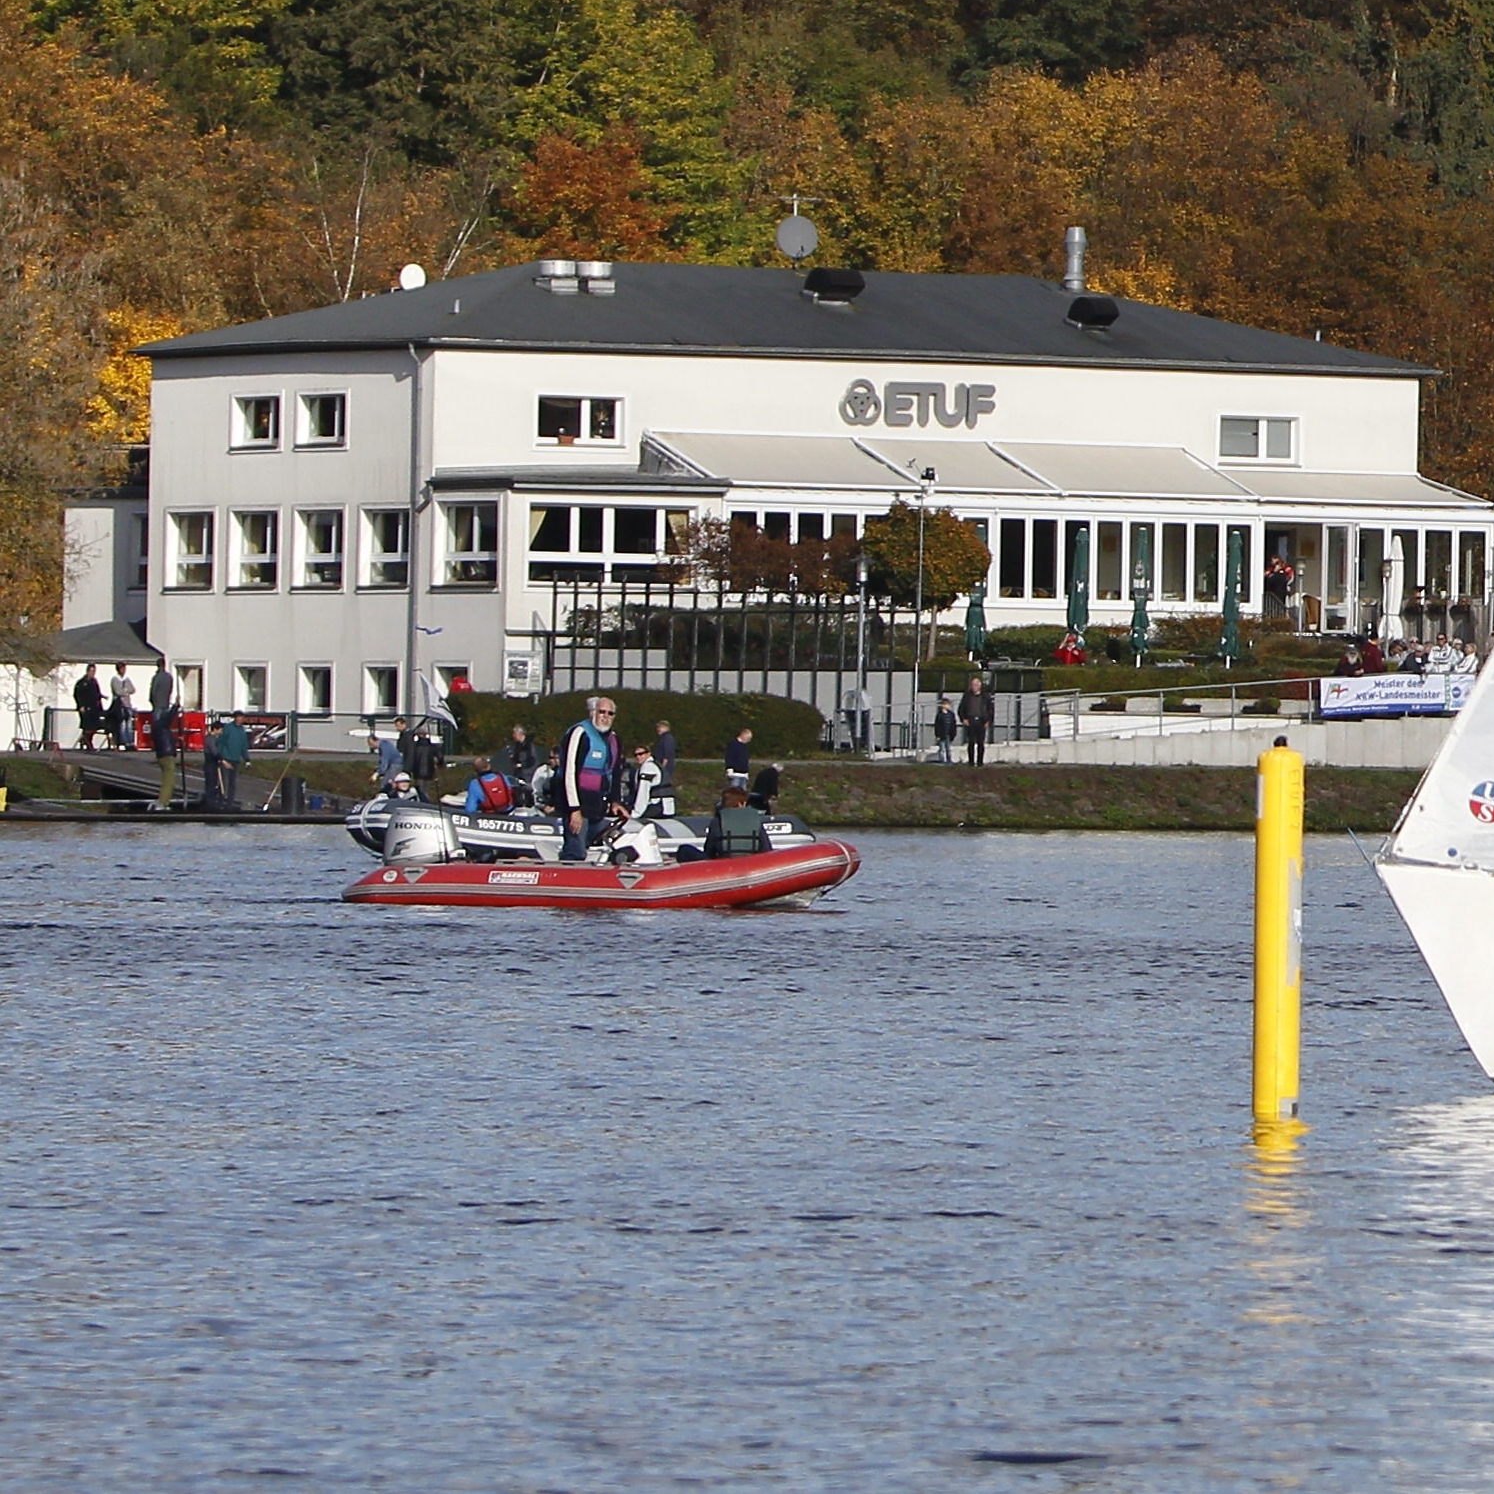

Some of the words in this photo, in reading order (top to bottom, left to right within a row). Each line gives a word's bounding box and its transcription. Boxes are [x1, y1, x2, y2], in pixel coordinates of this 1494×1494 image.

[884, 382, 996, 429] ETUF
[394, 822, 443, 831] HONDA
[476, 818, 525, 833] 165777S
